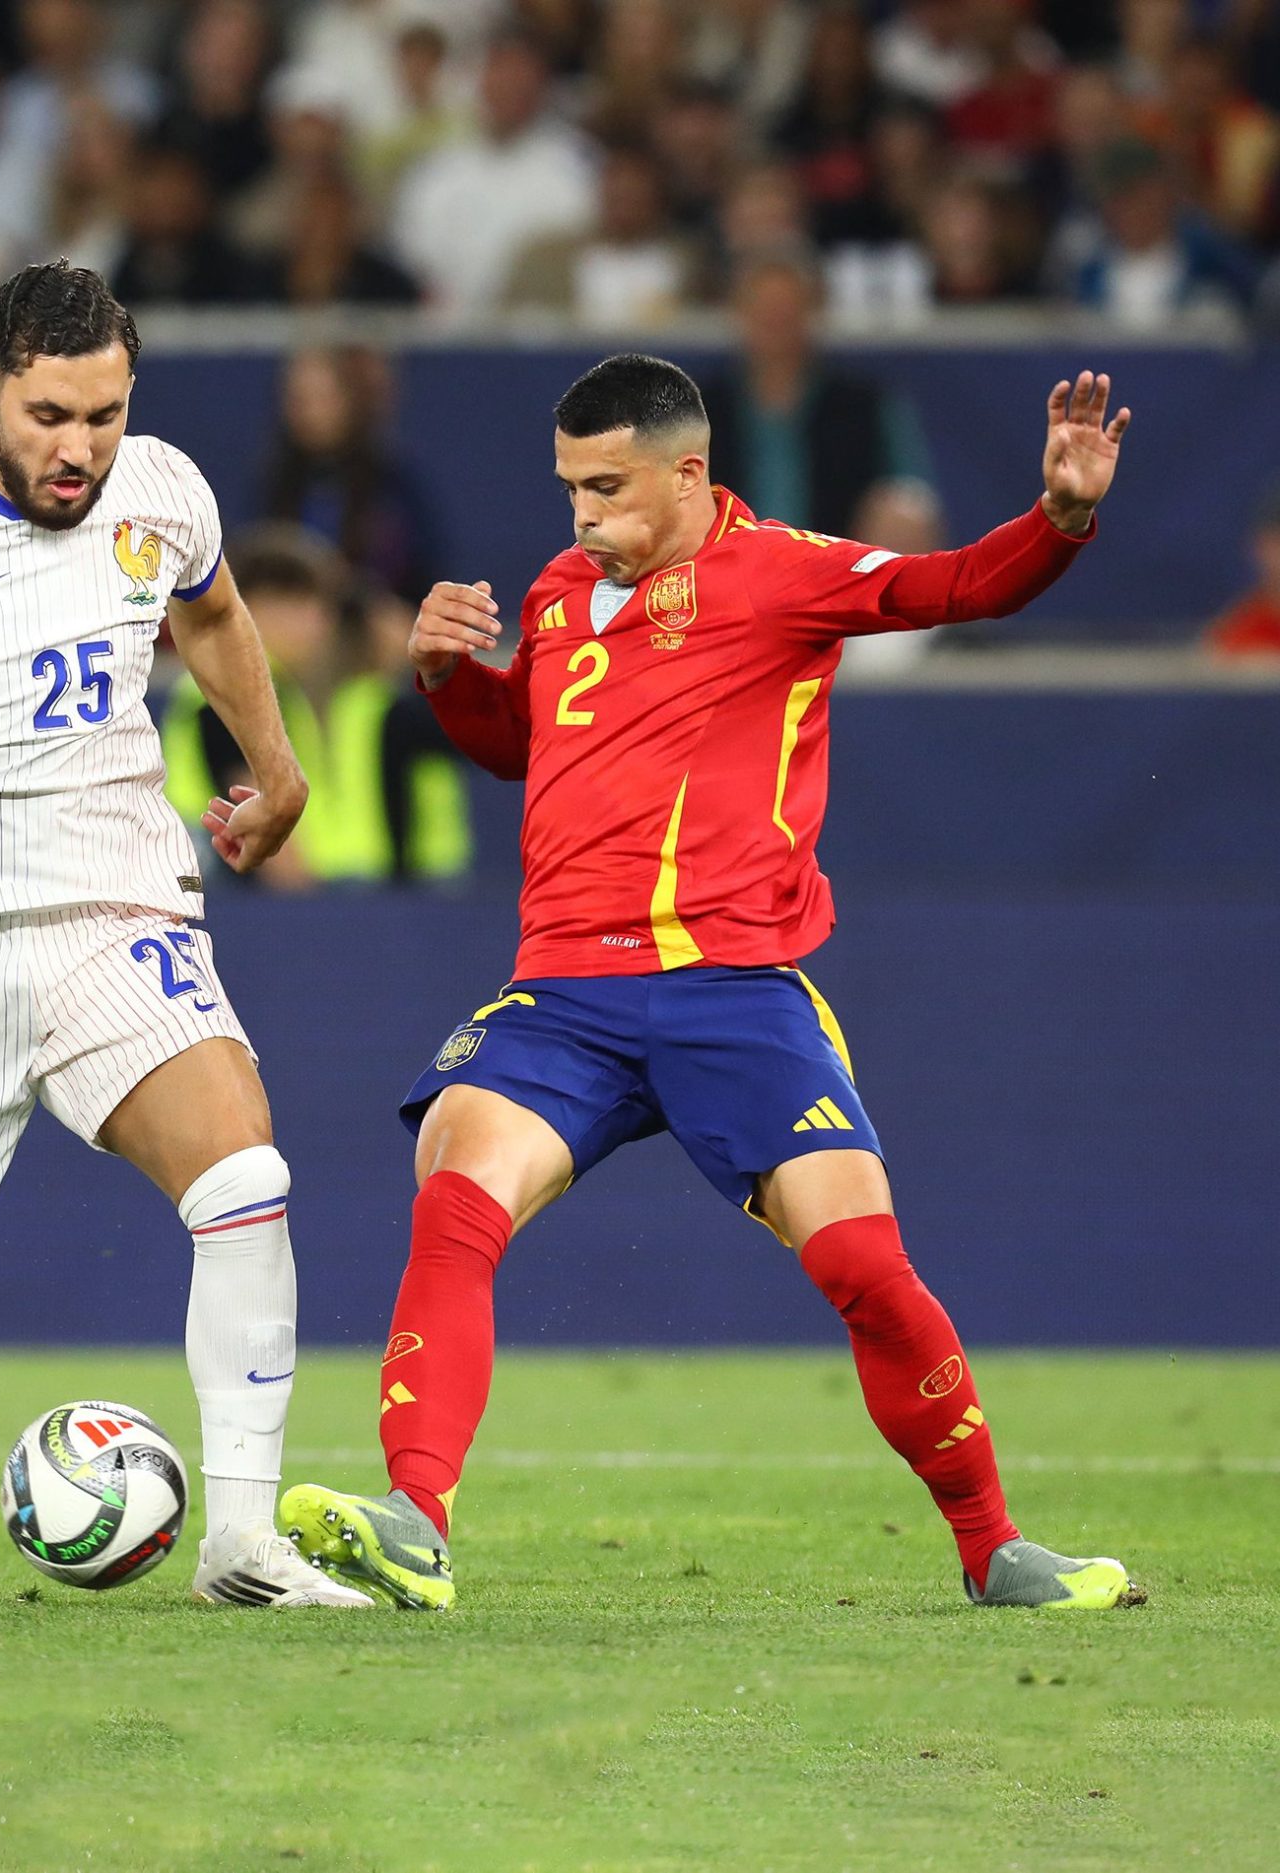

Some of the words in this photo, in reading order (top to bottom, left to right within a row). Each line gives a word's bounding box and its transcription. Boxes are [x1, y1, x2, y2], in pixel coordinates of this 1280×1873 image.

[31, 640, 114, 732] 25
[555, 640, 610, 726] 2
[47, 1410, 73, 1469] NATIONS
[57, 1518, 115, 1560] LEAGUE
